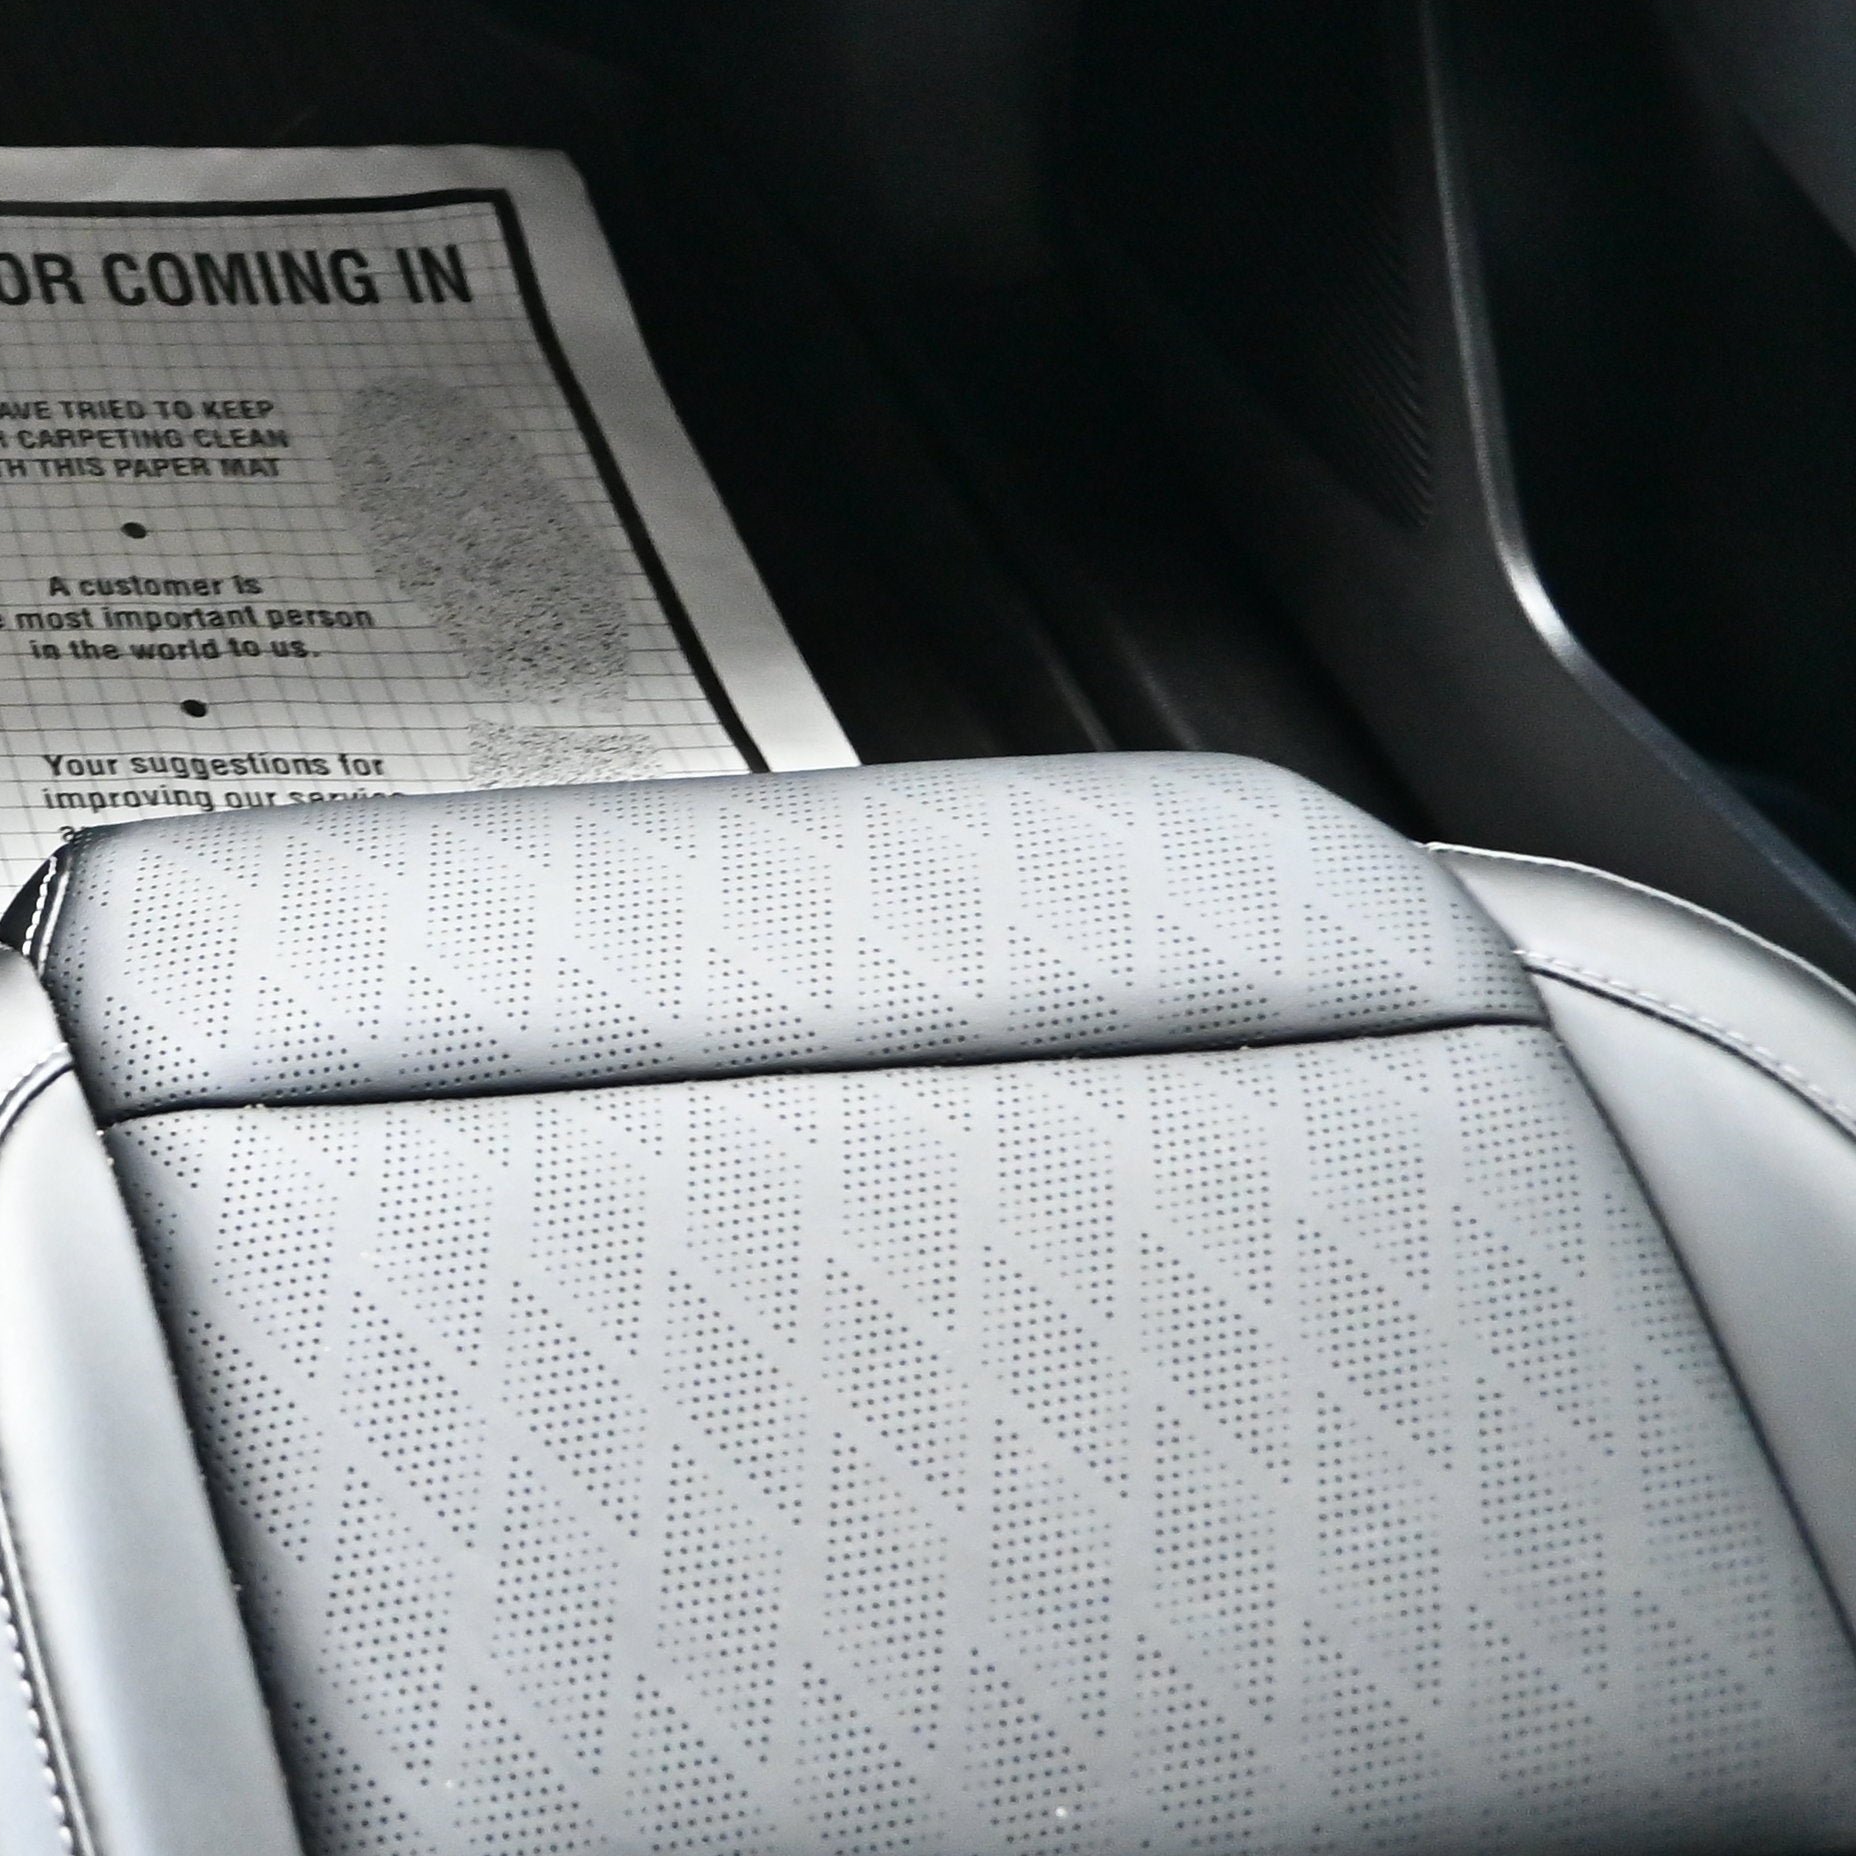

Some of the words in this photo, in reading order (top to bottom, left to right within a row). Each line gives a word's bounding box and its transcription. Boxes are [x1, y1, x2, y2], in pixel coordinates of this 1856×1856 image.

[102, 248, 380, 306] COMING
[396, 243, 473, 303] IN
[59, 400, 145, 419] TRIED
[153, 400, 192, 419] TO
[202, 401, 274, 419] KEEP
[17, 429, 185, 449] CARPETING
[193, 429, 289, 448] CLEAN
[37, 458, 106, 478] THIS
[113, 458, 211, 477] PAPER
[219, 457, 281, 477] MAT
[48, 575, 70, 597] A
[78, 576, 223, 596] customer
[232, 575, 263, 595] is
[16, 609, 92, 629] most
[102, 606, 258, 631] important
[267, 609, 375, 629] person
[29, 640, 59, 660] in
[68, 640, 120, 660] the
[129, 639, 220, 660] world
[228, 637, 260, 657] to
[268, 638, 321, 659] us.
[45, 754, 117, 777] Your
[131, 752, 330, 780] suggestions
[340, 752, 385, 776] for
[44, 786, 215, 813] improving
[224, 791, 278, 808] our
